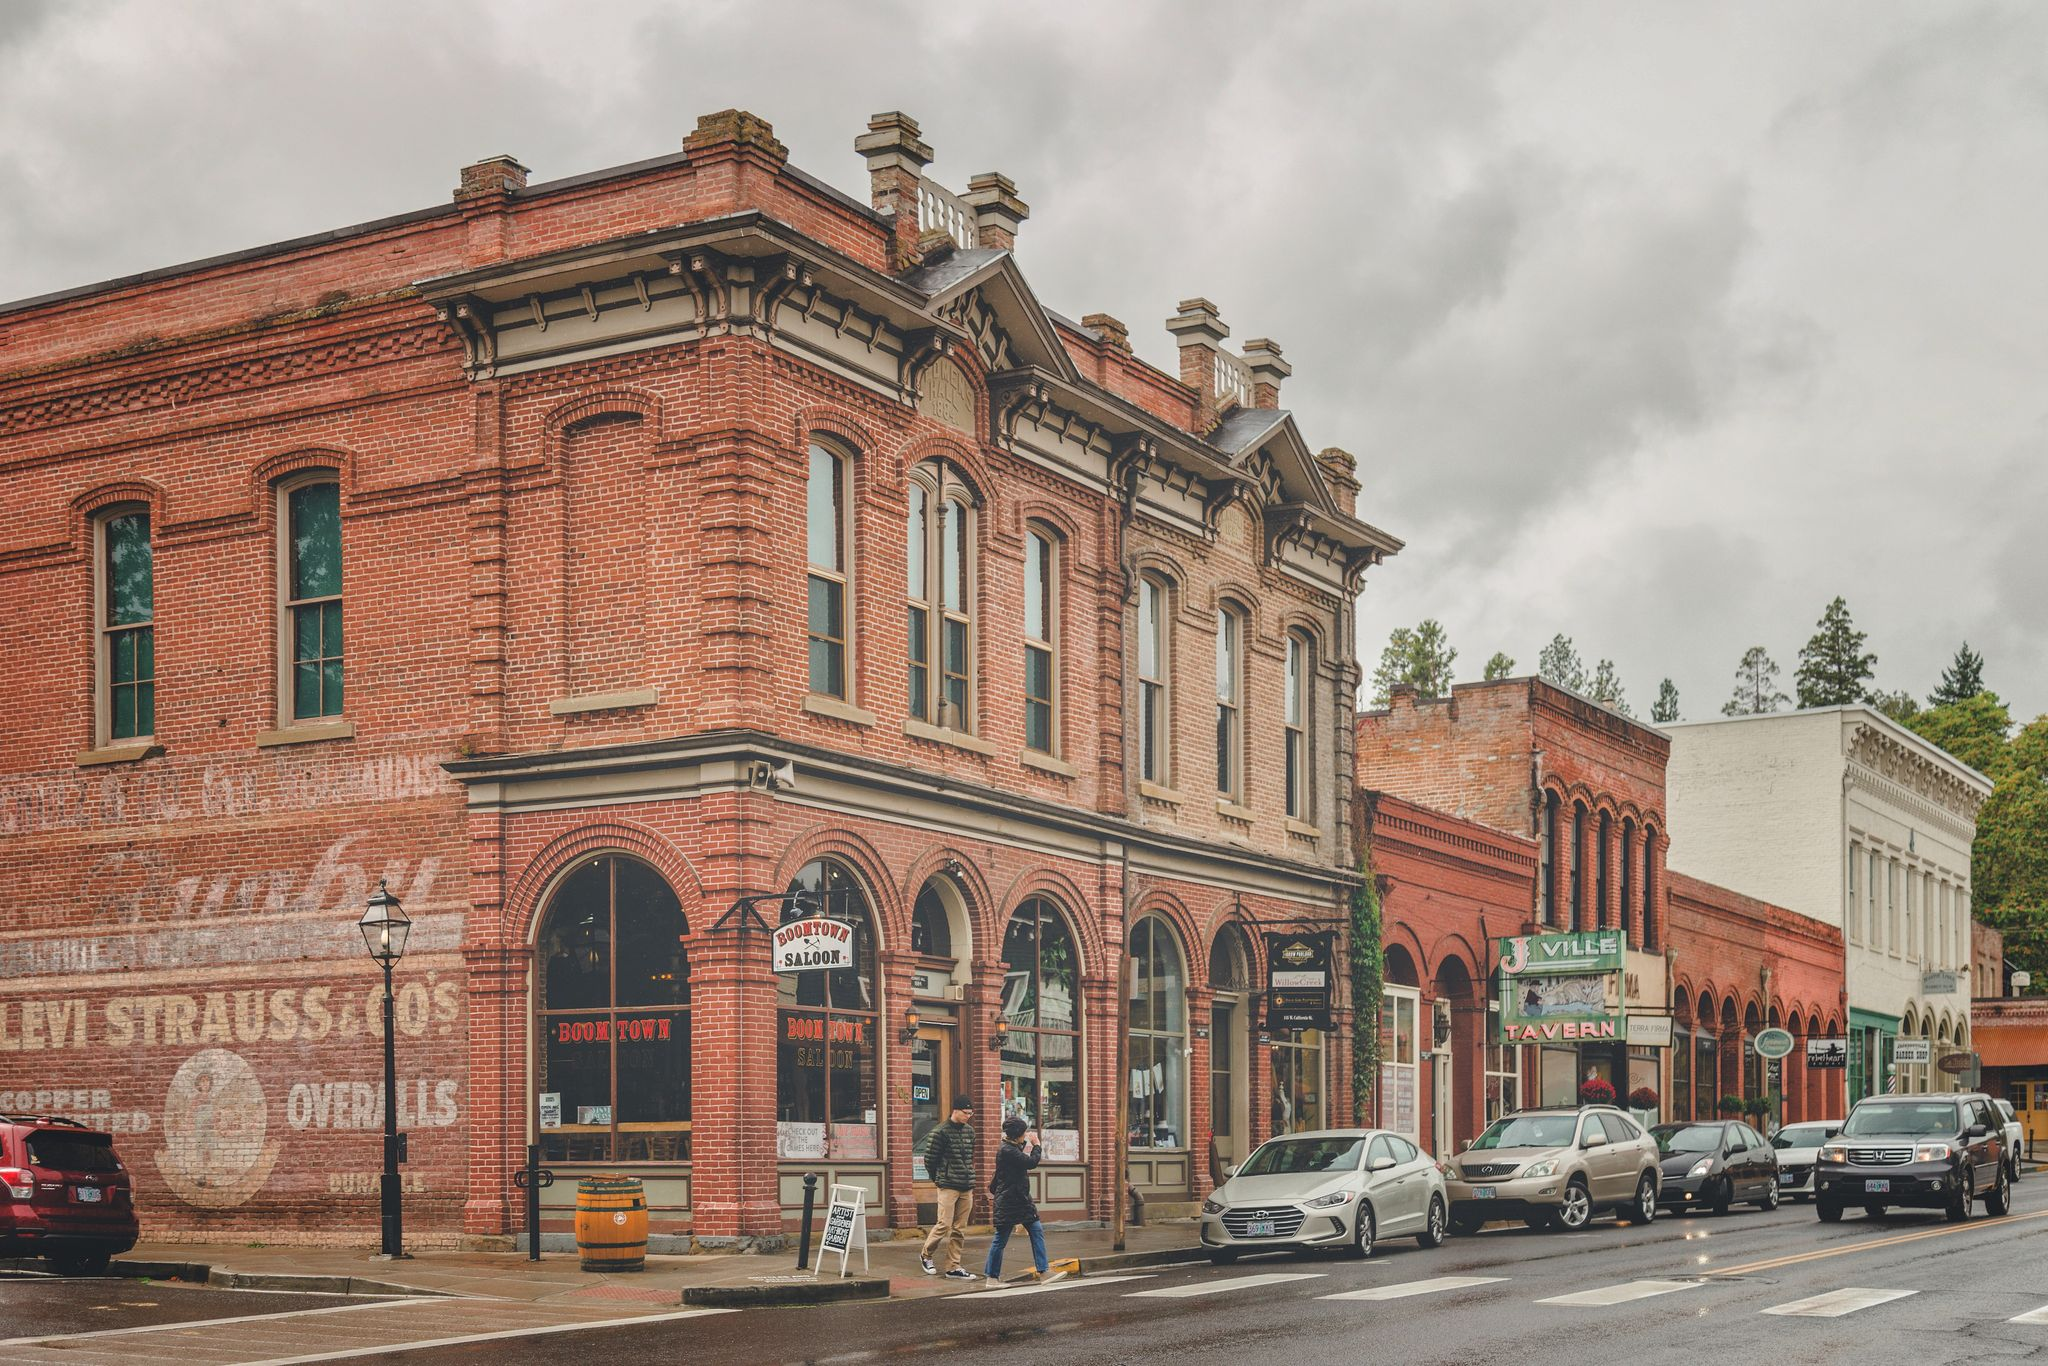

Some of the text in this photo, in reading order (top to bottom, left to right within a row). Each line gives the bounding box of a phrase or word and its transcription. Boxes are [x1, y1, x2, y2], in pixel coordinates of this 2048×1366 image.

[929, 381, 958, 413] HALL
[776, 921, 850, 947] BOOMTOWN
[785, 950, 840, 967] SALOON
[1501, 937, 1617, 973] J VILLE
[0, 998, 87, 1050] LEVI
[105, 985, 332, 1047] STRAUSS
[1504, 1020, 1616, 1040] TAVERN
[1629, 1024, 1669, 1033] TERRA FIRMA
[1896, 1051, 1928, 1060] BARBER SHOP
[0, 1088, 112, 1112] COPPER
[914, 1087, 929, 1099] OPEN
[788, 1127, 818, 1136] CHECK OUT
[805, 1144, 820, 1152] HERE
[832, 1206, 855, 1218] ARTIST
